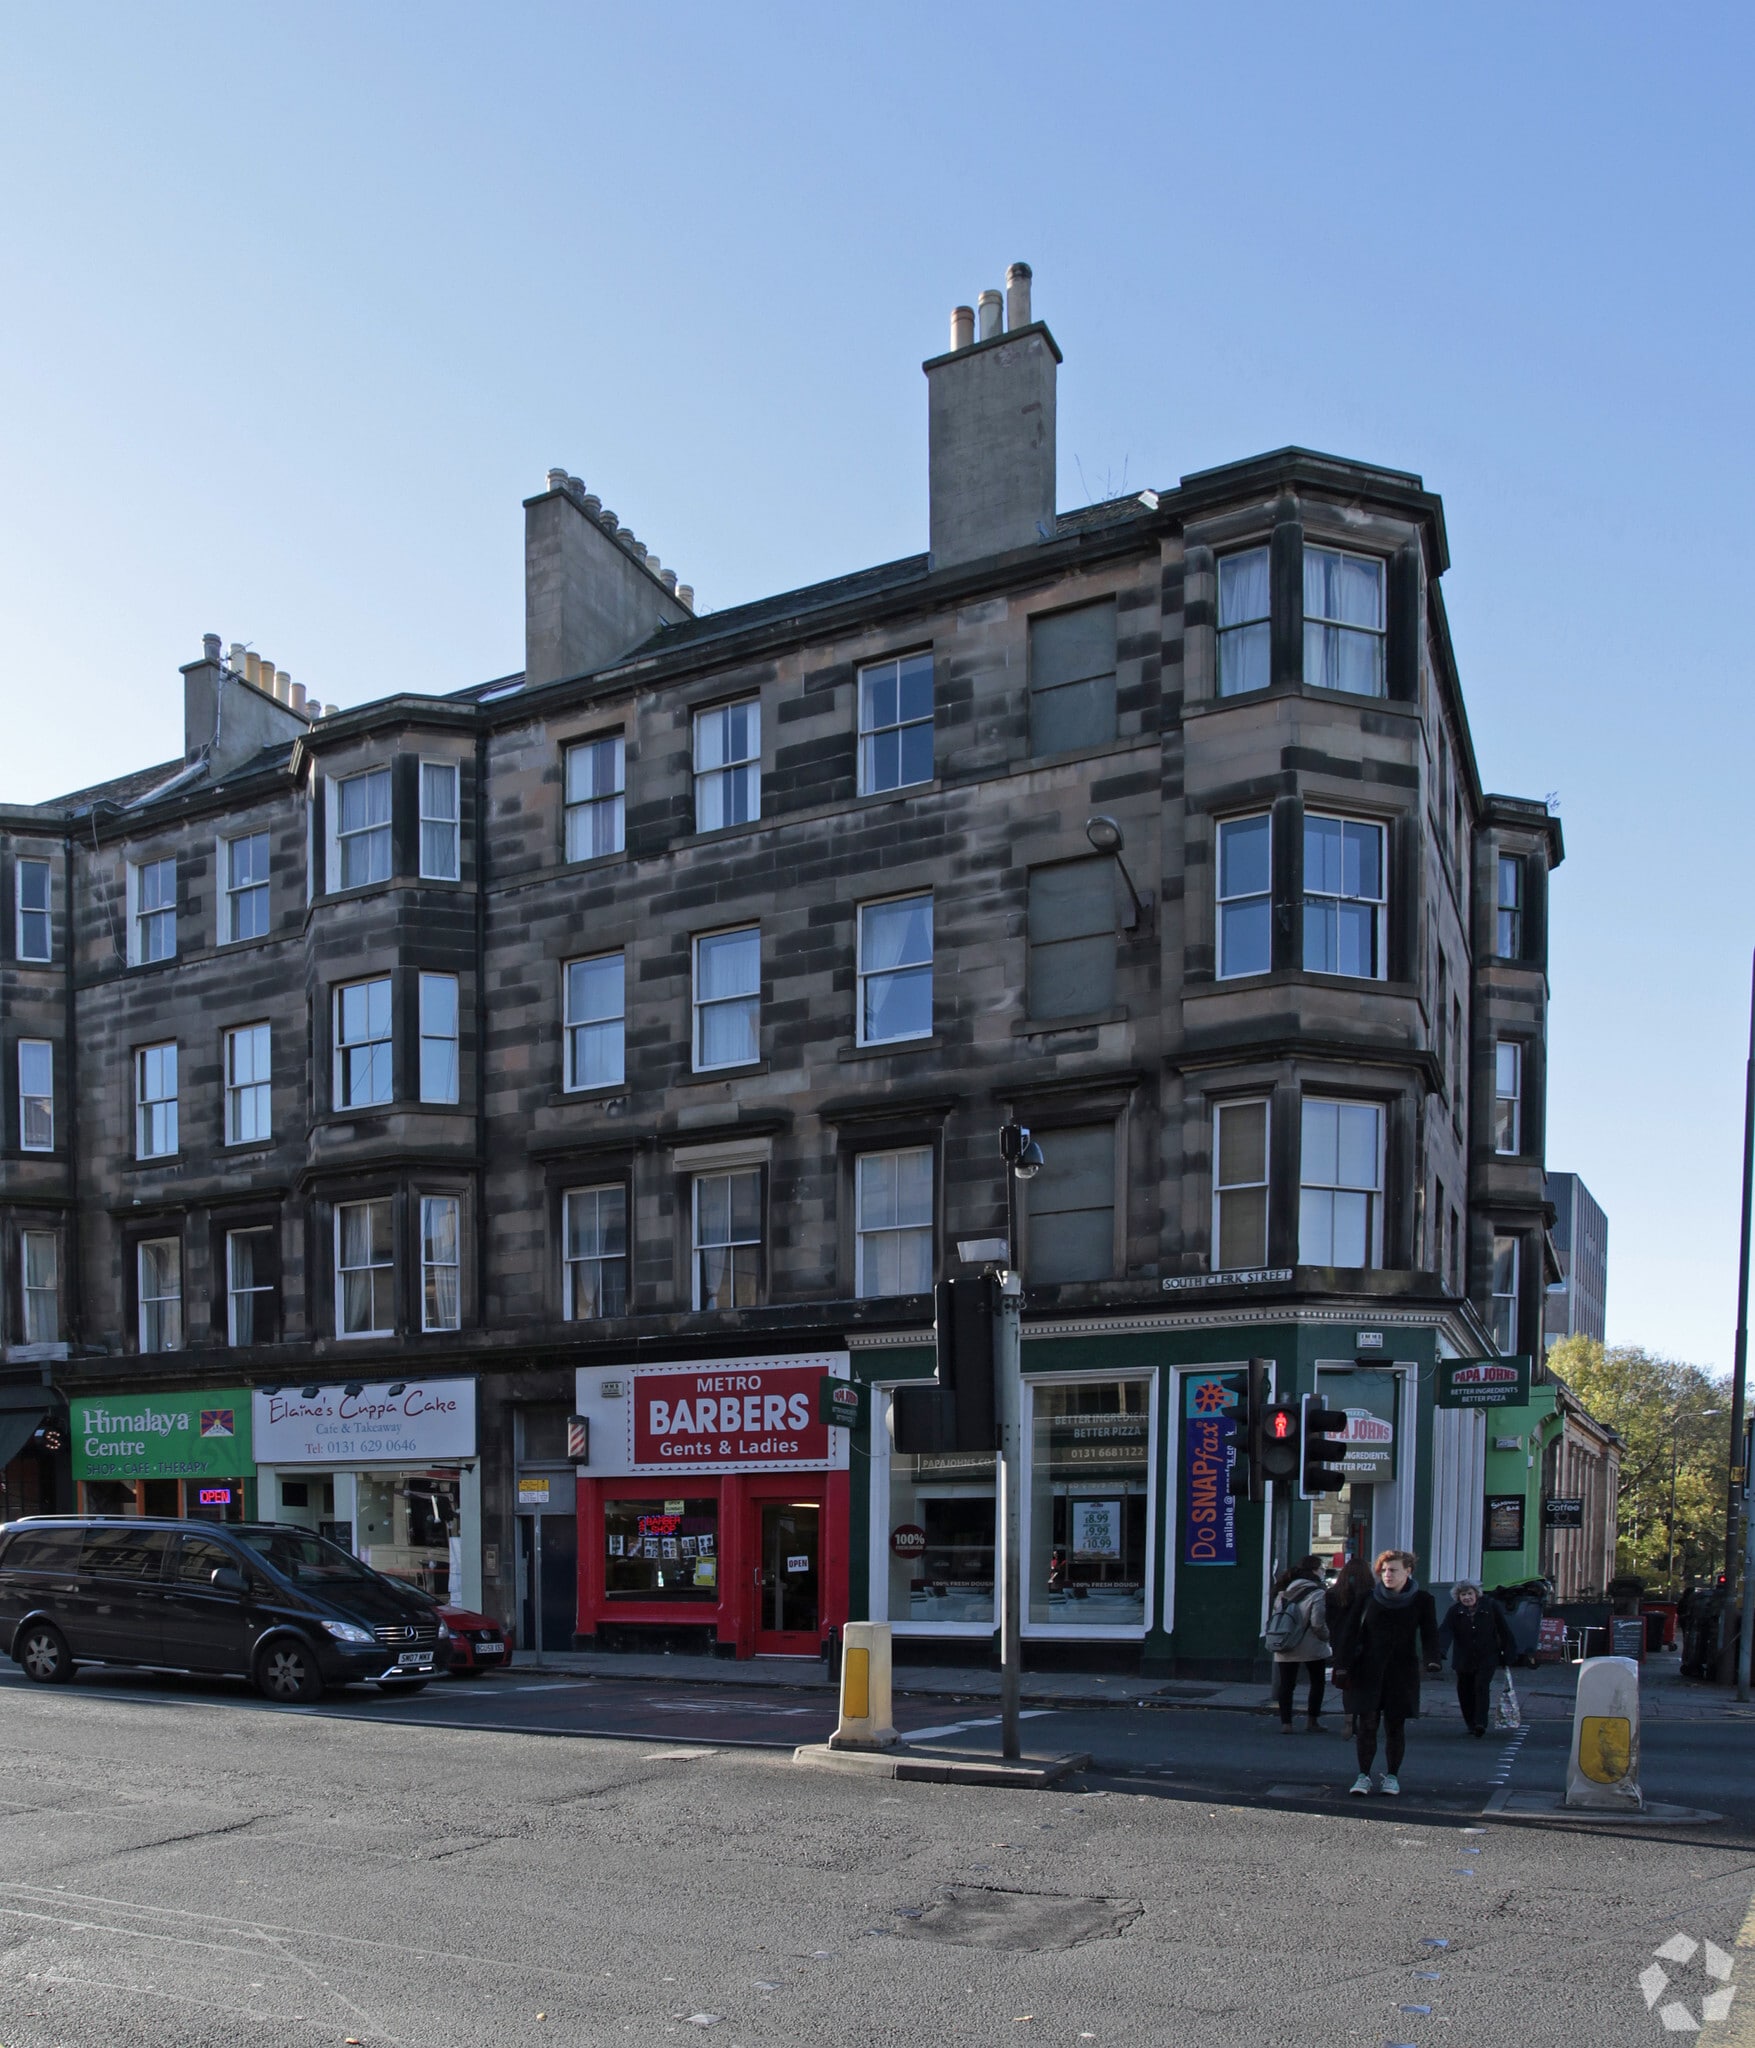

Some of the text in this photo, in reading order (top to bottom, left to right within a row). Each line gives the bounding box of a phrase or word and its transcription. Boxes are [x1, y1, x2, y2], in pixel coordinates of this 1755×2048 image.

[1165, 1270, 1290, 1289] SOUTH CLERK STREET
[1455, 1367, 1516, 1382] PAPA JOHNS
[697, 1375, 762, 1393] METRO
[1451, 1388, 1476, 1396] BETTER
[1461, 1394, 1506, 1403] BETTER PIZZA
[269, 1389, 457, 1424] Elaine's Cuppa Cake
[650, 1393, 810, 1435] BARBERS
[1055, 1414, 1091, 1426] BETTER
[83, 1406, 190, 1437] Himalaya
[316, 1421, 403, 1436] Cafe & Takeaway
[1074, 1426, 1141, 1438] BETTER PIZZA
[1351, 1419, 1390, 1440] JOHNS
[84, 1437, 146, 1458] Centre
[304, 1438, 417, 1455] Tel: 0131 629 0646
[660, 1437, 799, 1456] Gents & Ladies
[1071, 1447, 1144, 1459] 0131 6681122
[86, 1461, 209, 1476] SHOP CAFE THERAPY
[1330, 1462, 1377, 1471] BETTER PIZZA
[1191, 1421, 1224, 1558] Do SNAPfax
[201, 1490, 230, 1503] OPEN
[1224, 1495, 1234, 1505] @
[1546, 1503, 1580, 1511] Coffee
[646, 1516, 681, 1526] BARBER
[1085, 1513, 1109, 1524] £8.99
[651, 1525, 677, 1534] SHOP
[1085, 1526, 1109, 1536] £9.99
[1224, 1507, 1234, 1549] available
[895, 1533, 925, 1545] 100%
[1082, 1539, 1112, 1549] £10.99
[788, 1560, 808, 1568] OPEN
